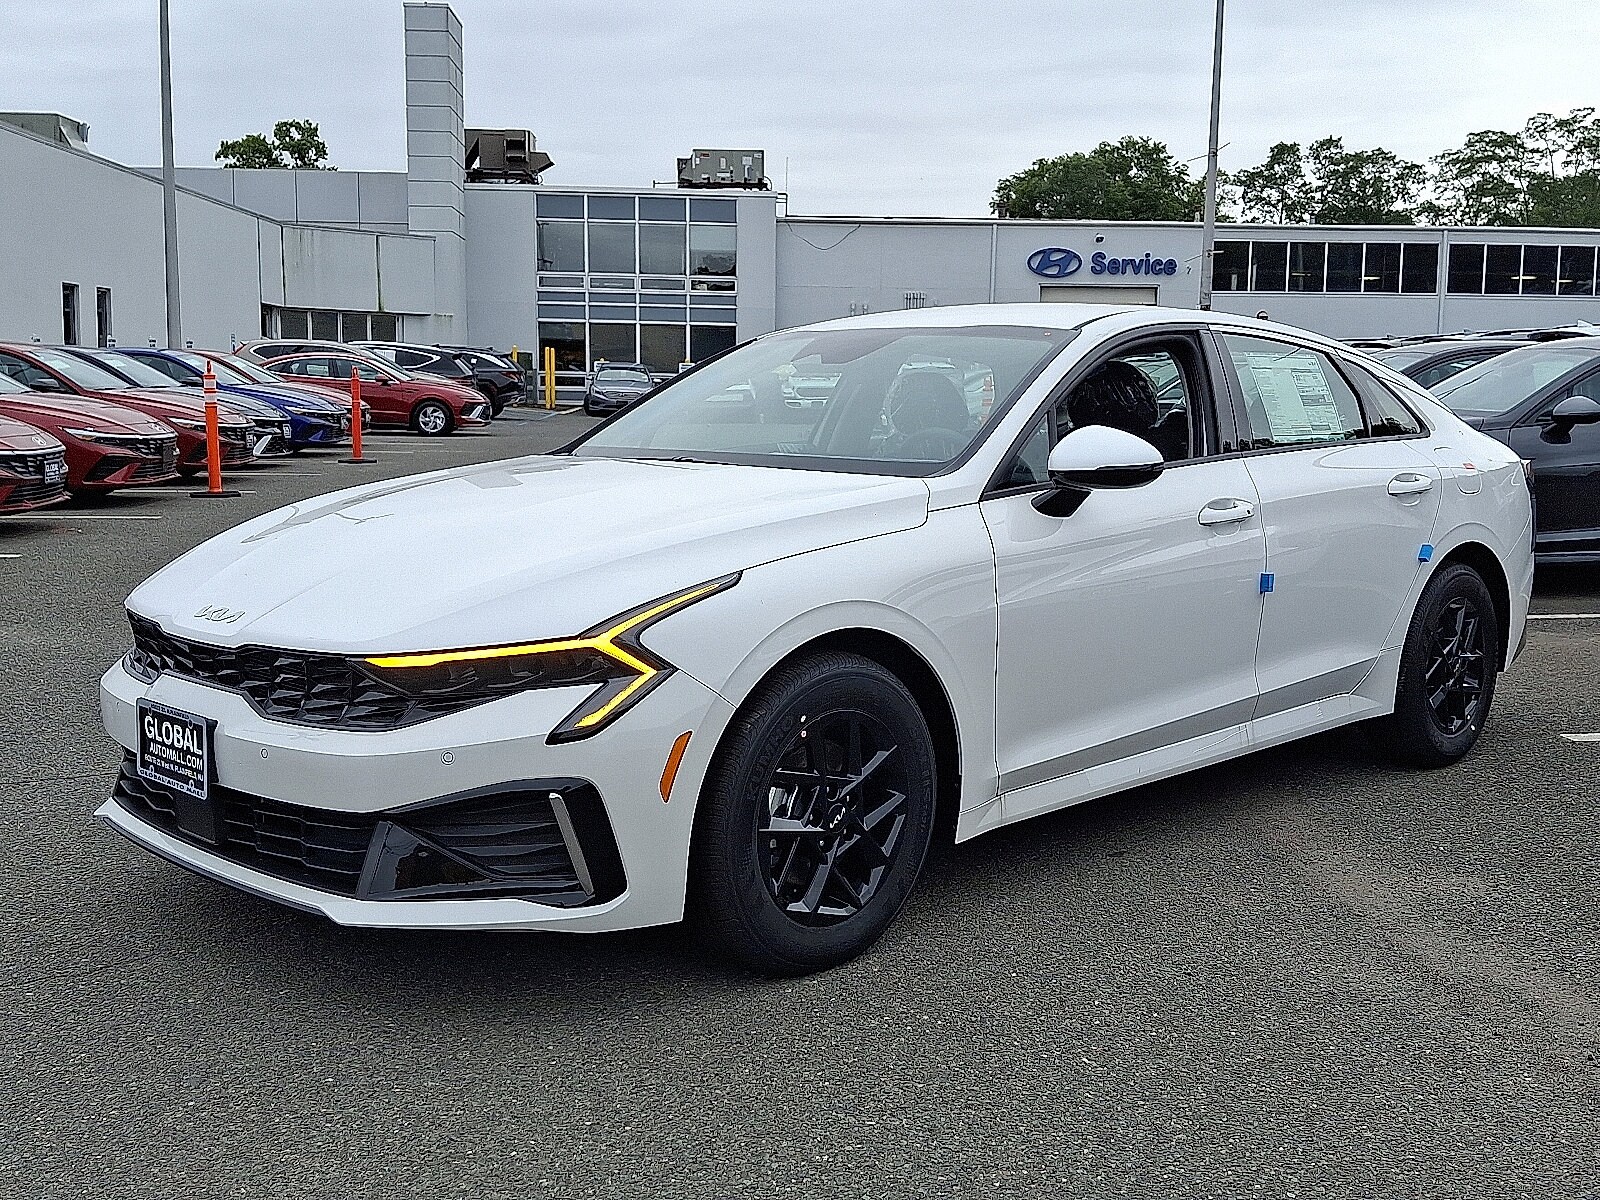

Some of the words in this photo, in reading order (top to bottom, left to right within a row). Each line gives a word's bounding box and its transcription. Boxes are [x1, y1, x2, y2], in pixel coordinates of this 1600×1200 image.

[1091, 252, 1177, 275] Service
[193, 605, 245, 624] KIA
[145, 716, 202, 755] GLOBAL
[150, 742, 203, 771] AUTOMALL.COM
[140, 769, 166, 783] GLOBAL
[167, 780, 185, 790] AUTO
